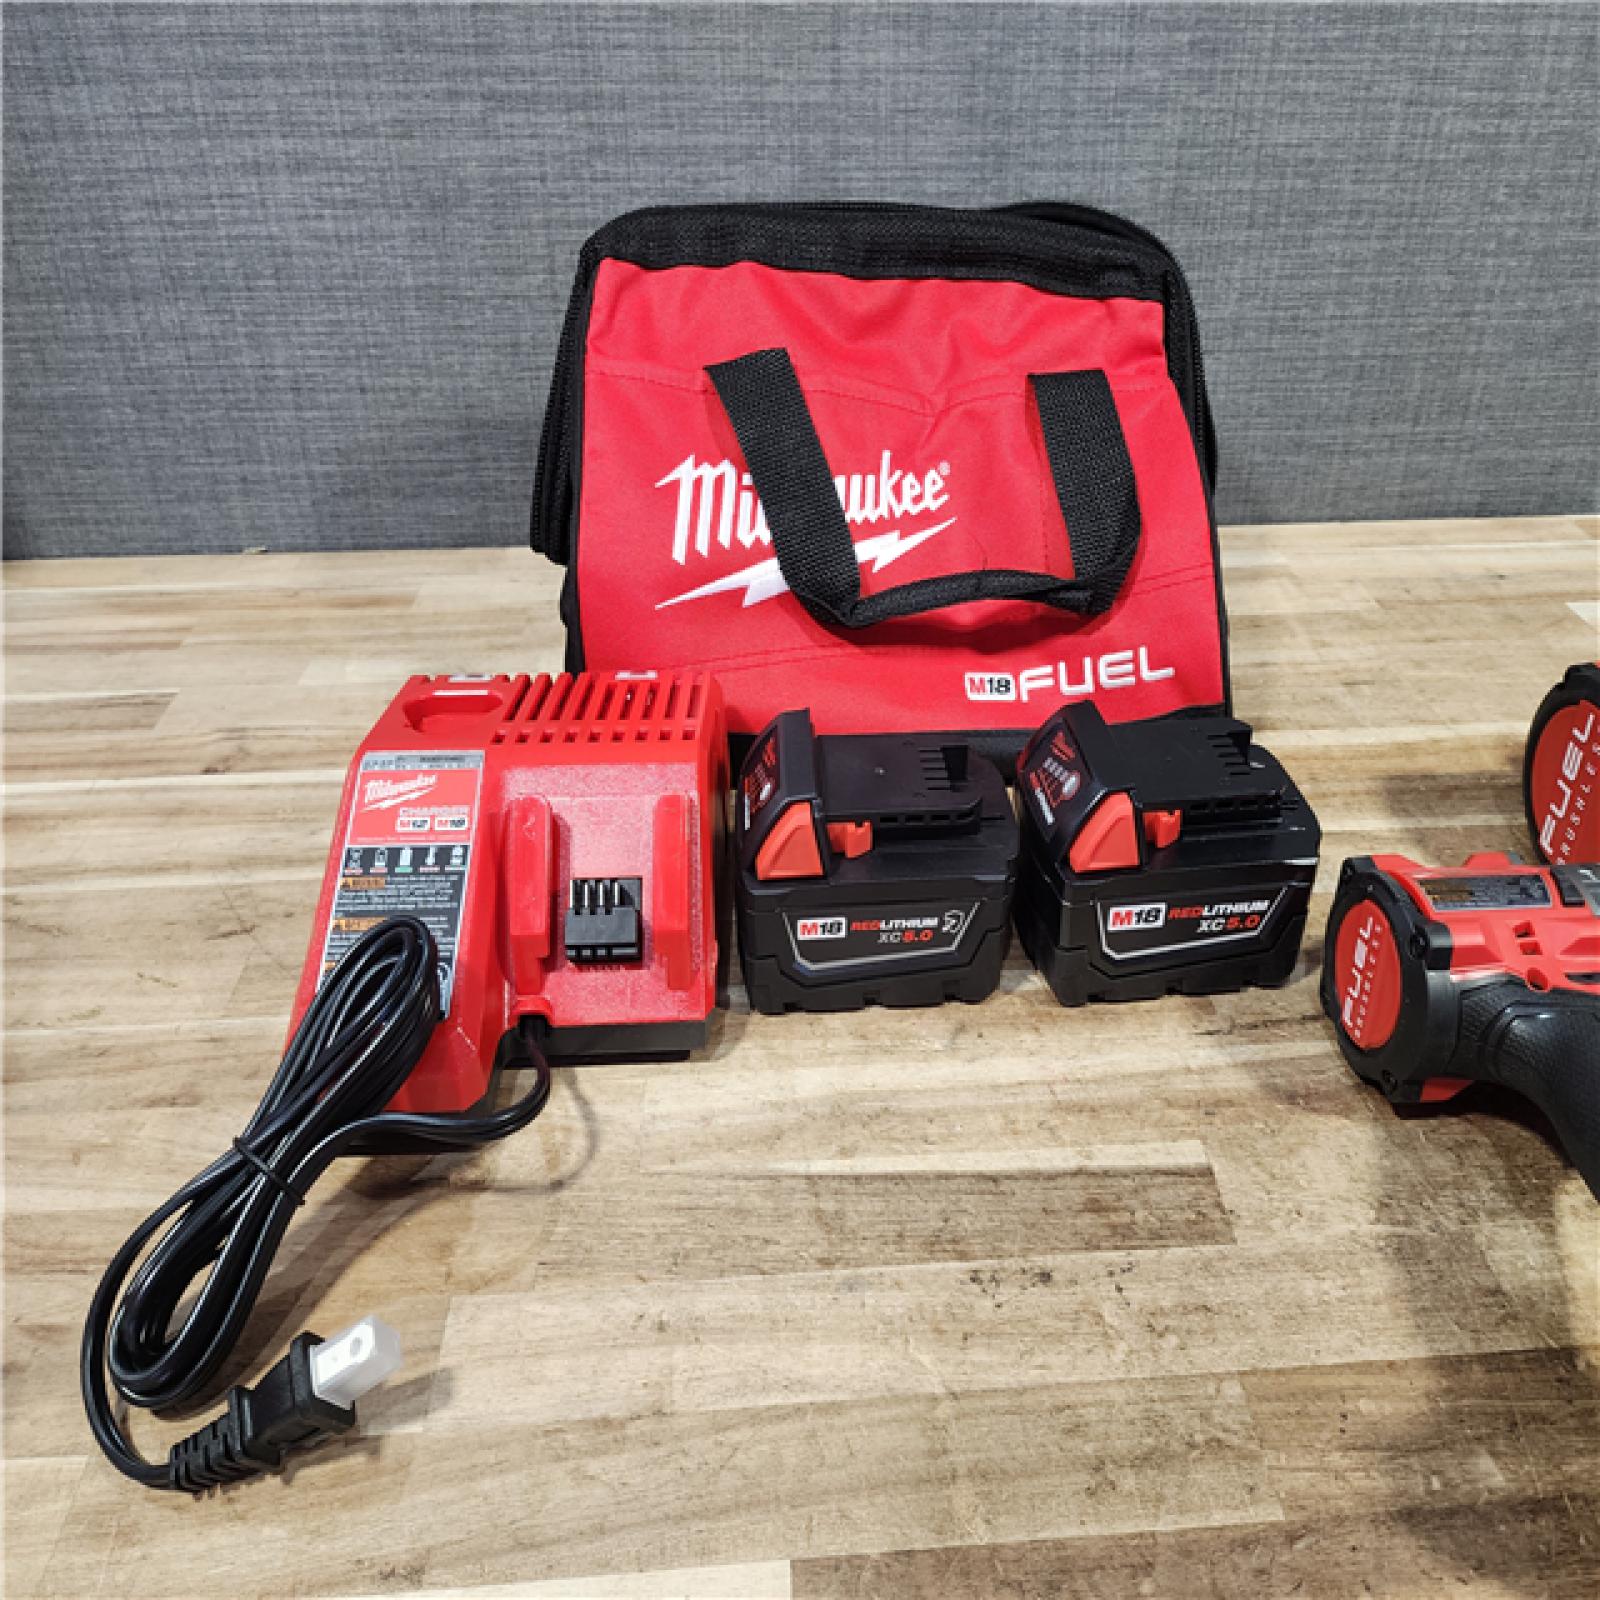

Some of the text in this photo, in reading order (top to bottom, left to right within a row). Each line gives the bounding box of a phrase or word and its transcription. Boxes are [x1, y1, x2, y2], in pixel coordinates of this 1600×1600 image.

[655, 450, 949, 566] Miukee
[967, 646, 1175, 703] M18 FUEL
[1540, 712, 1596, 856] FUEL
[799, 919, 844, 938] M18
[1110, 905, 1163, 928] M18
